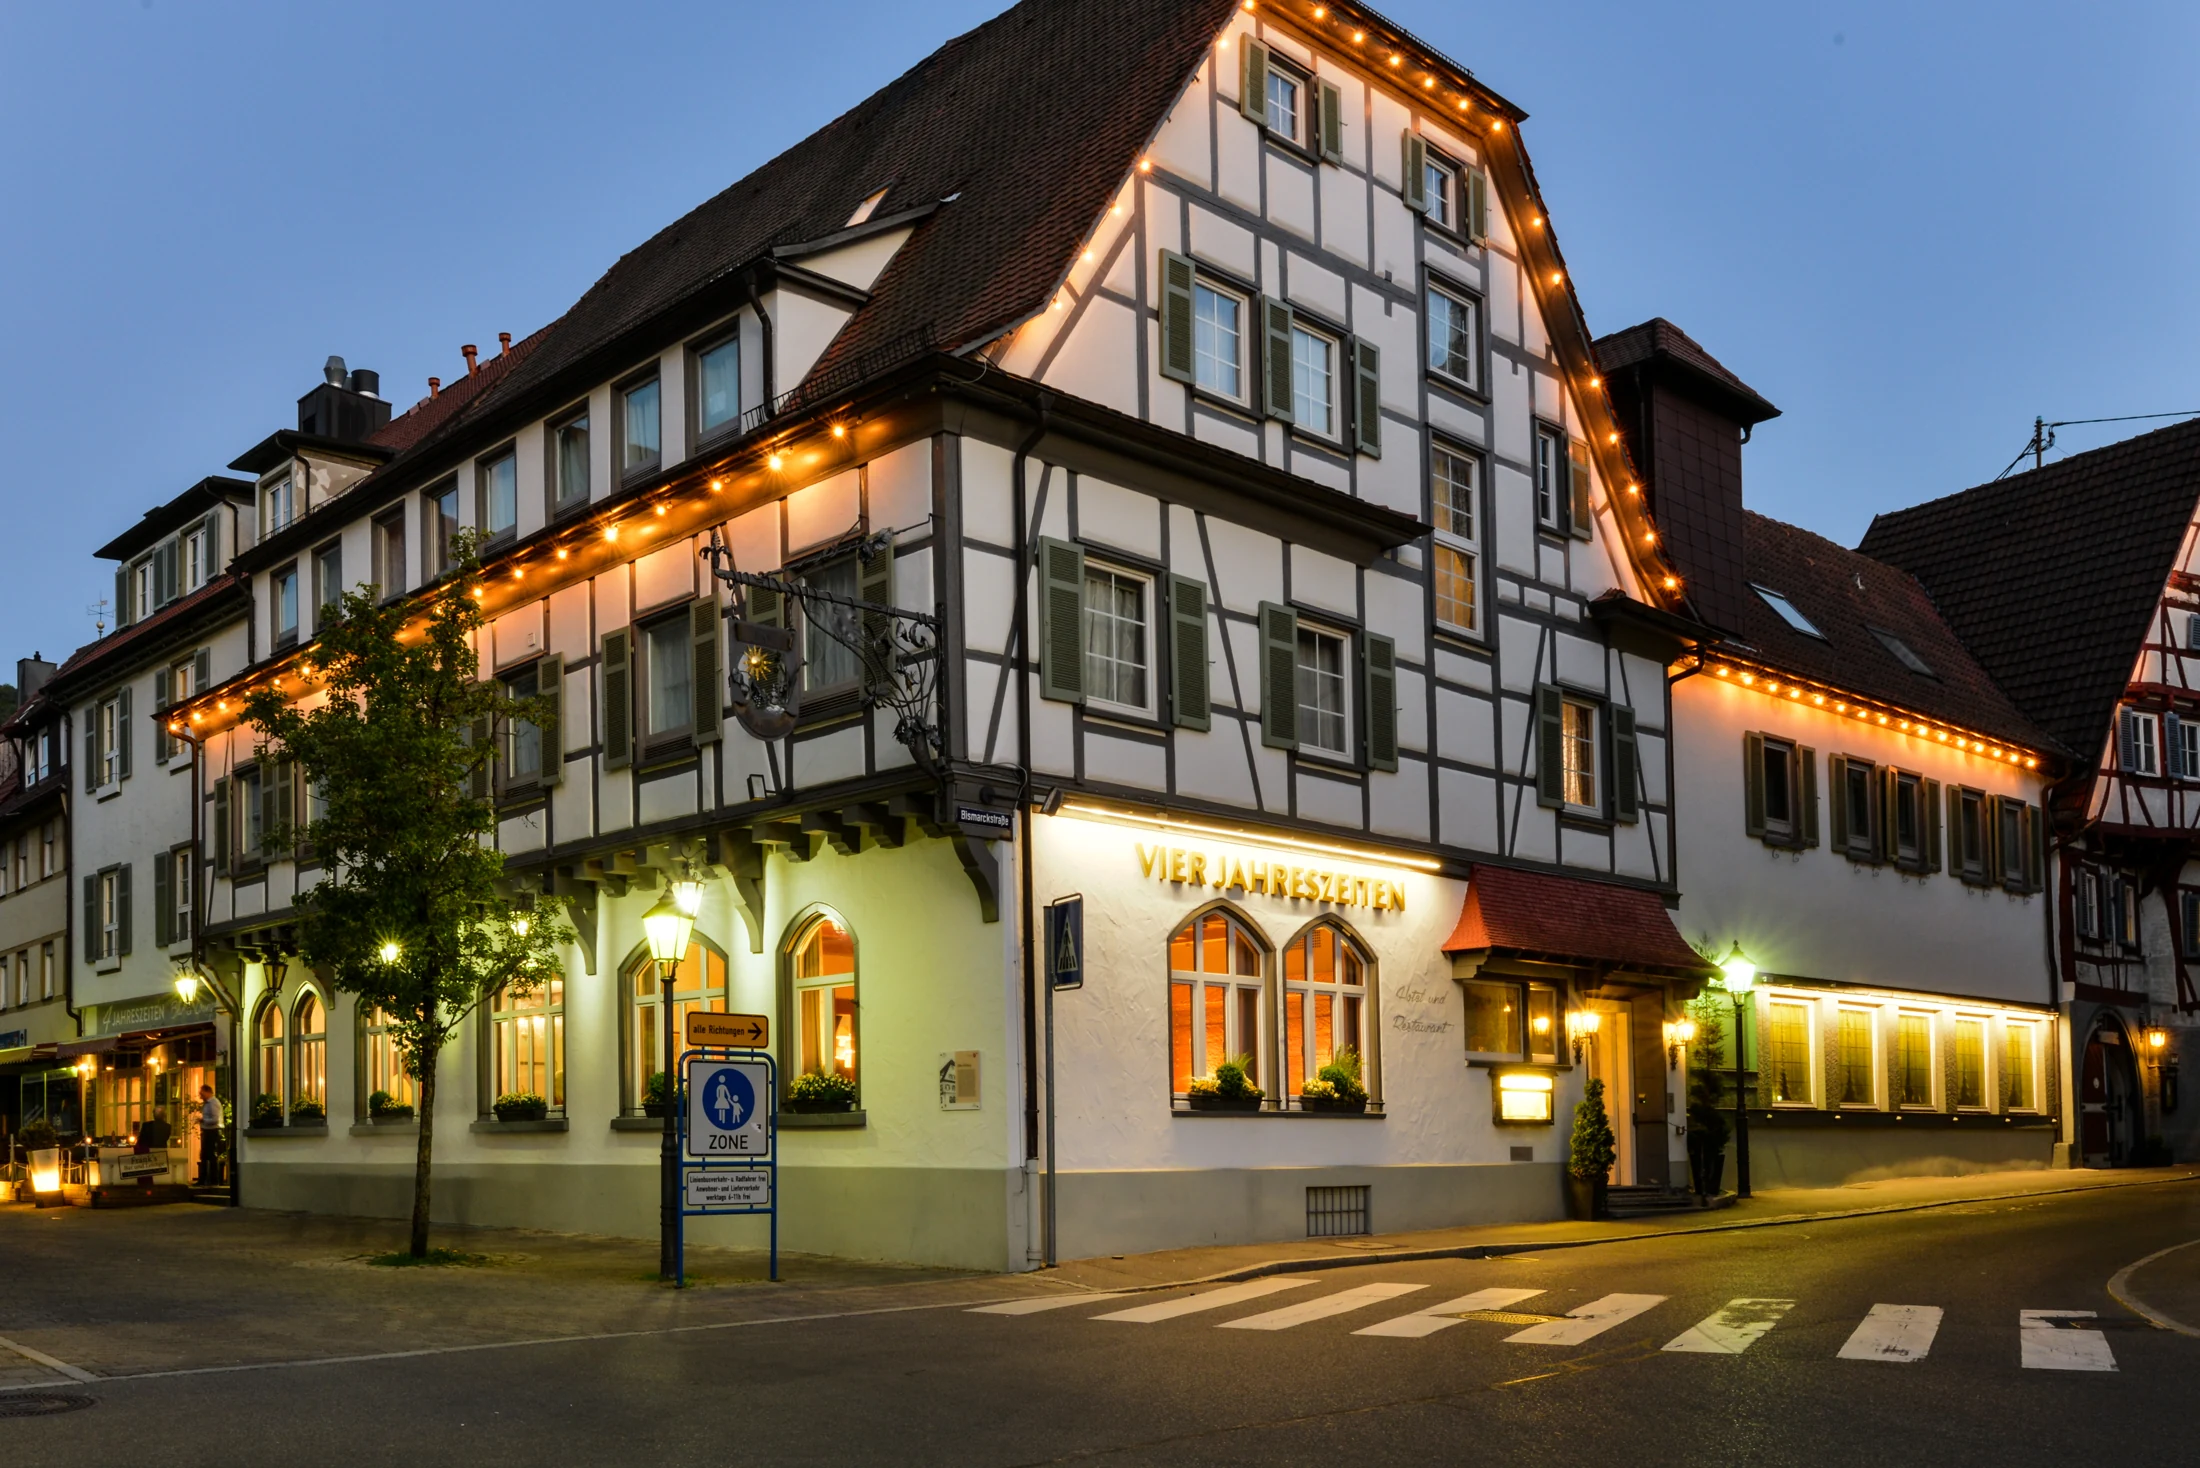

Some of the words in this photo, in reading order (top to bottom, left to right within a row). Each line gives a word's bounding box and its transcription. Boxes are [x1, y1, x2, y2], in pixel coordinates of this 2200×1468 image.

[961, 810, 1009, 826] Bismarckstraße
[1135, 842, 1207, 886] VIER
[1213, 855, 1406, 912] JAHRESZEITEN
[1396, 984, 1426, 1003] Hotel
[1428, 990, 1449, 1004] und
[102, 1004, 113, 1033] 4
[112, 1005, 165, 1026] JAHRESZEITEN
[1393, 1015, 1454, 1033] Restaurant
[693, 1025, 706, 1034] alle
[708, 1024, 745, 1038] Richtungen
[709, 1134, 749, 1150] ZONE
[706, 1194, 727, 1202] werktags
